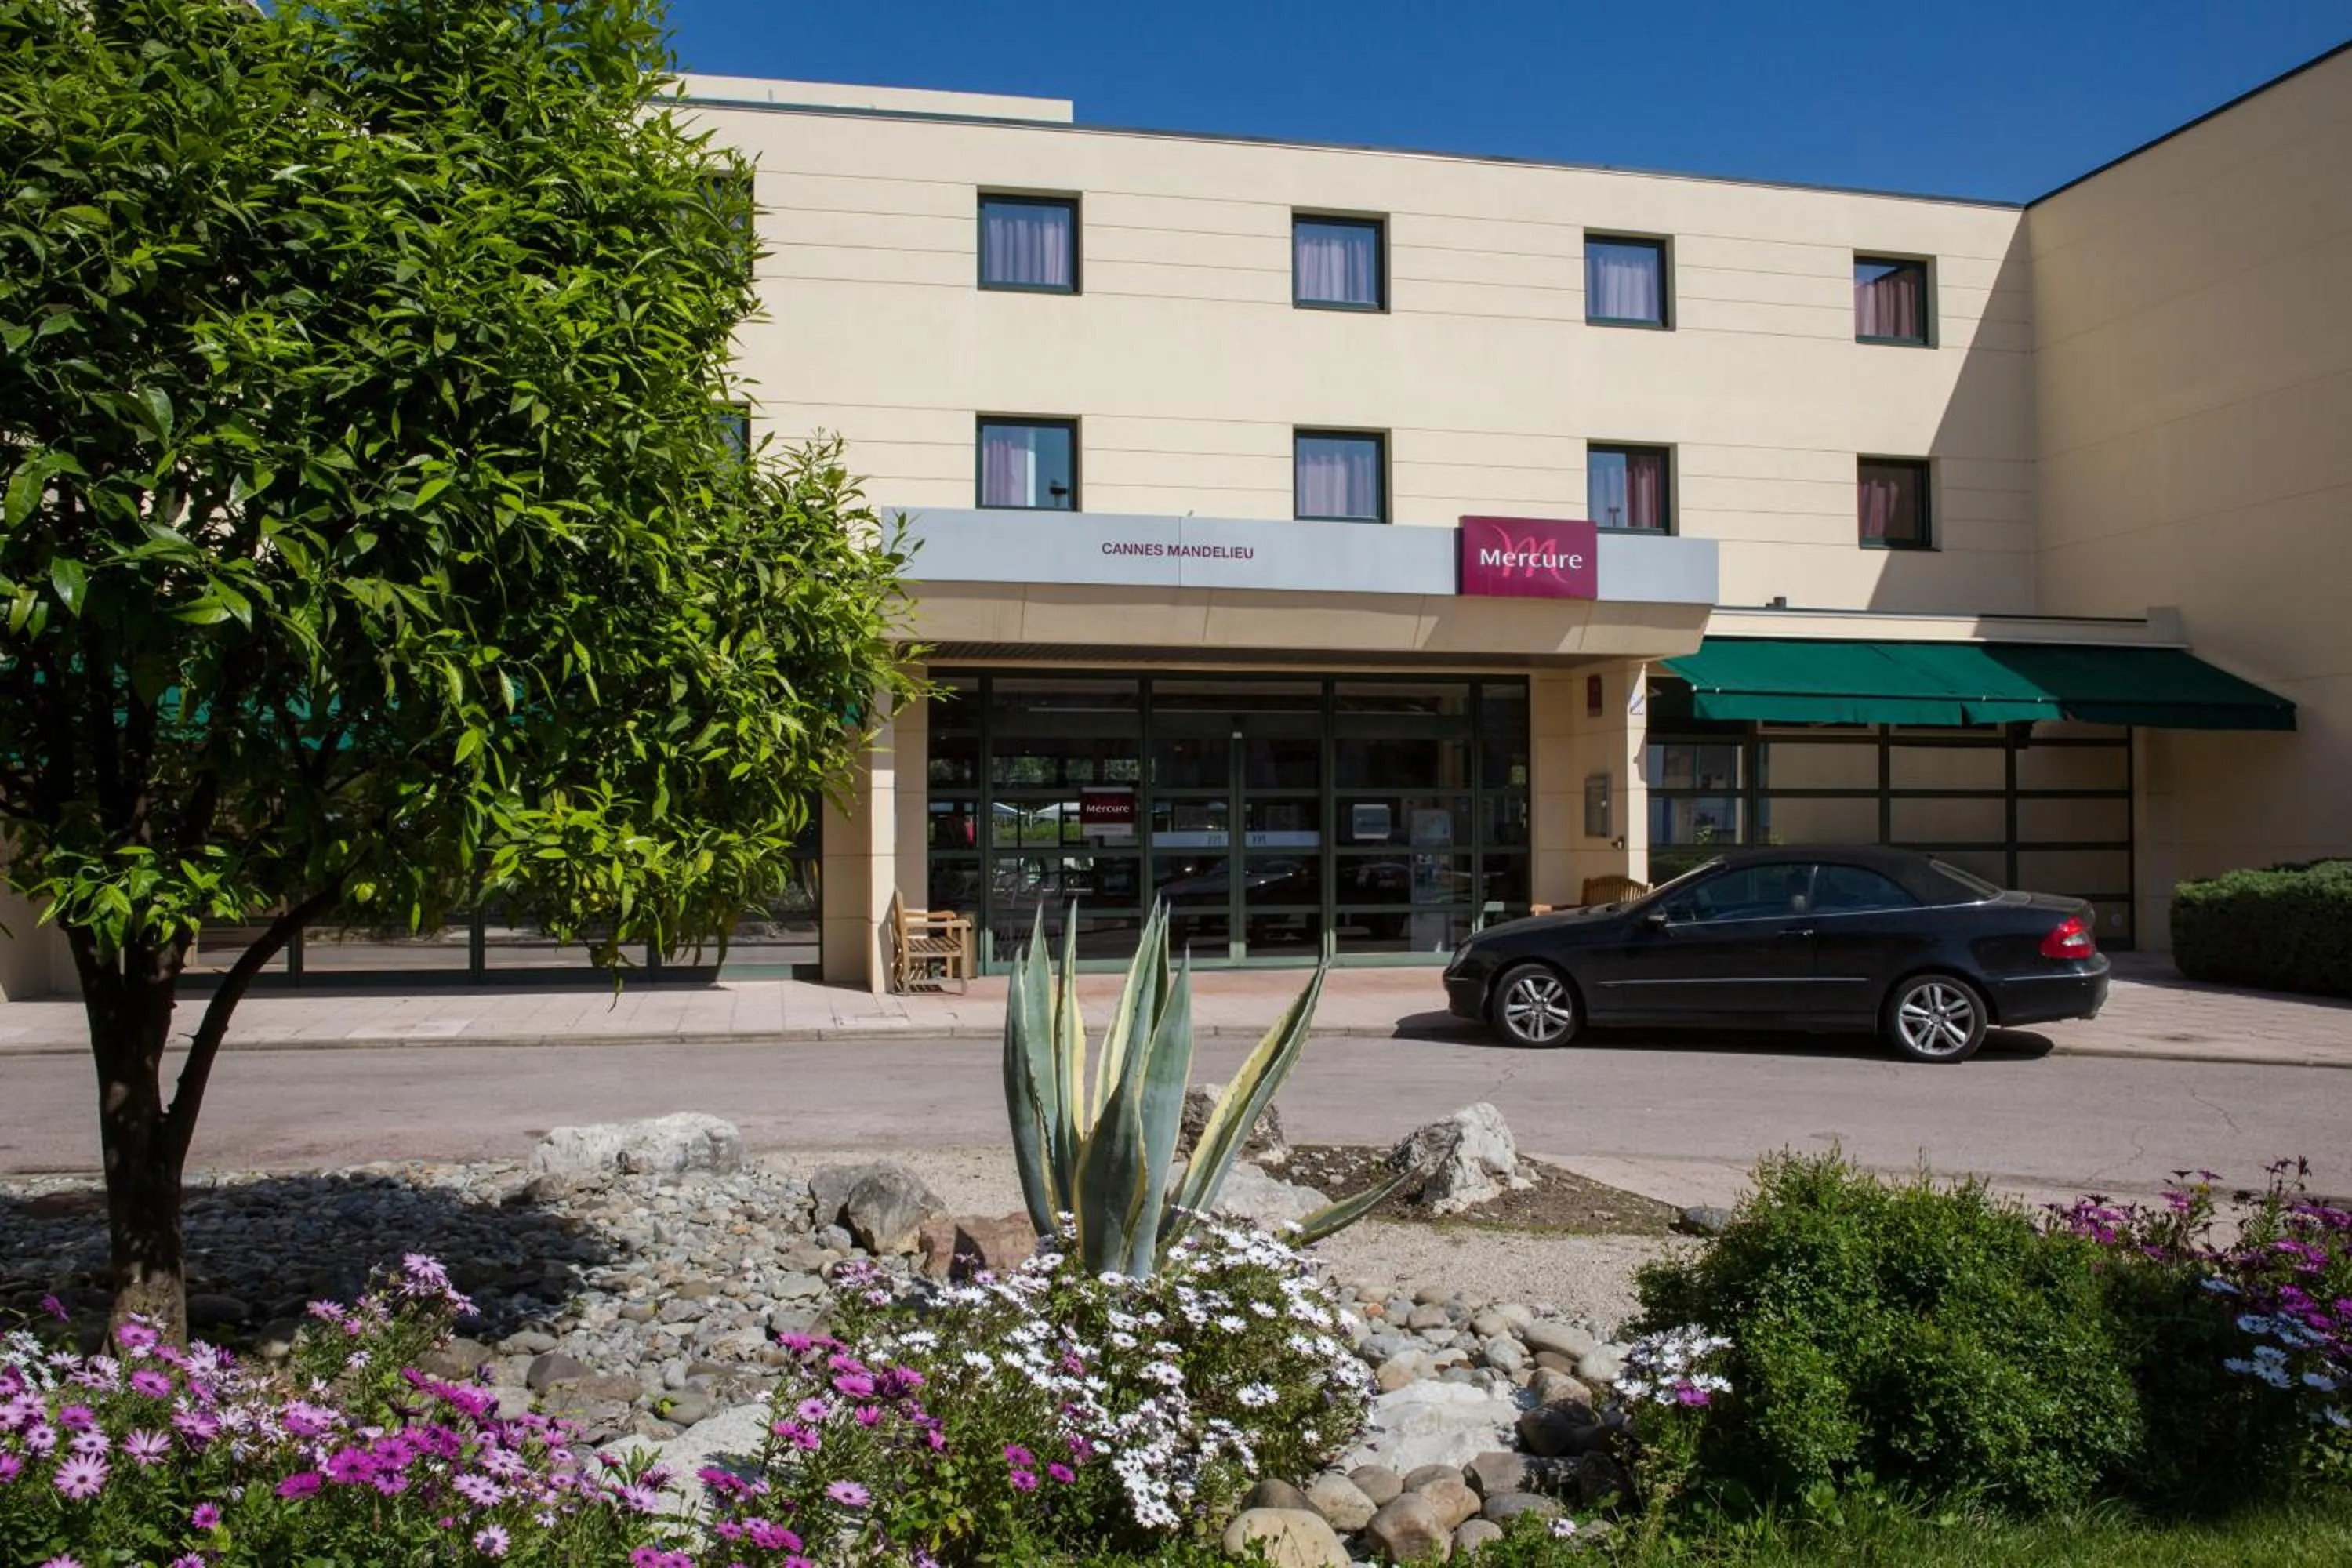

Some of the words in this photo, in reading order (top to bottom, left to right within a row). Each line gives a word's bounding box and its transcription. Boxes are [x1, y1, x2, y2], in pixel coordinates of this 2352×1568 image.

[1102, 542, 1163, 555] CANNES
[1167, 544, 1254, 558] MANDELIEU
[1479, 548, 1583, 569] Mercure
[1086, 804, 1130, 813] Mercure
